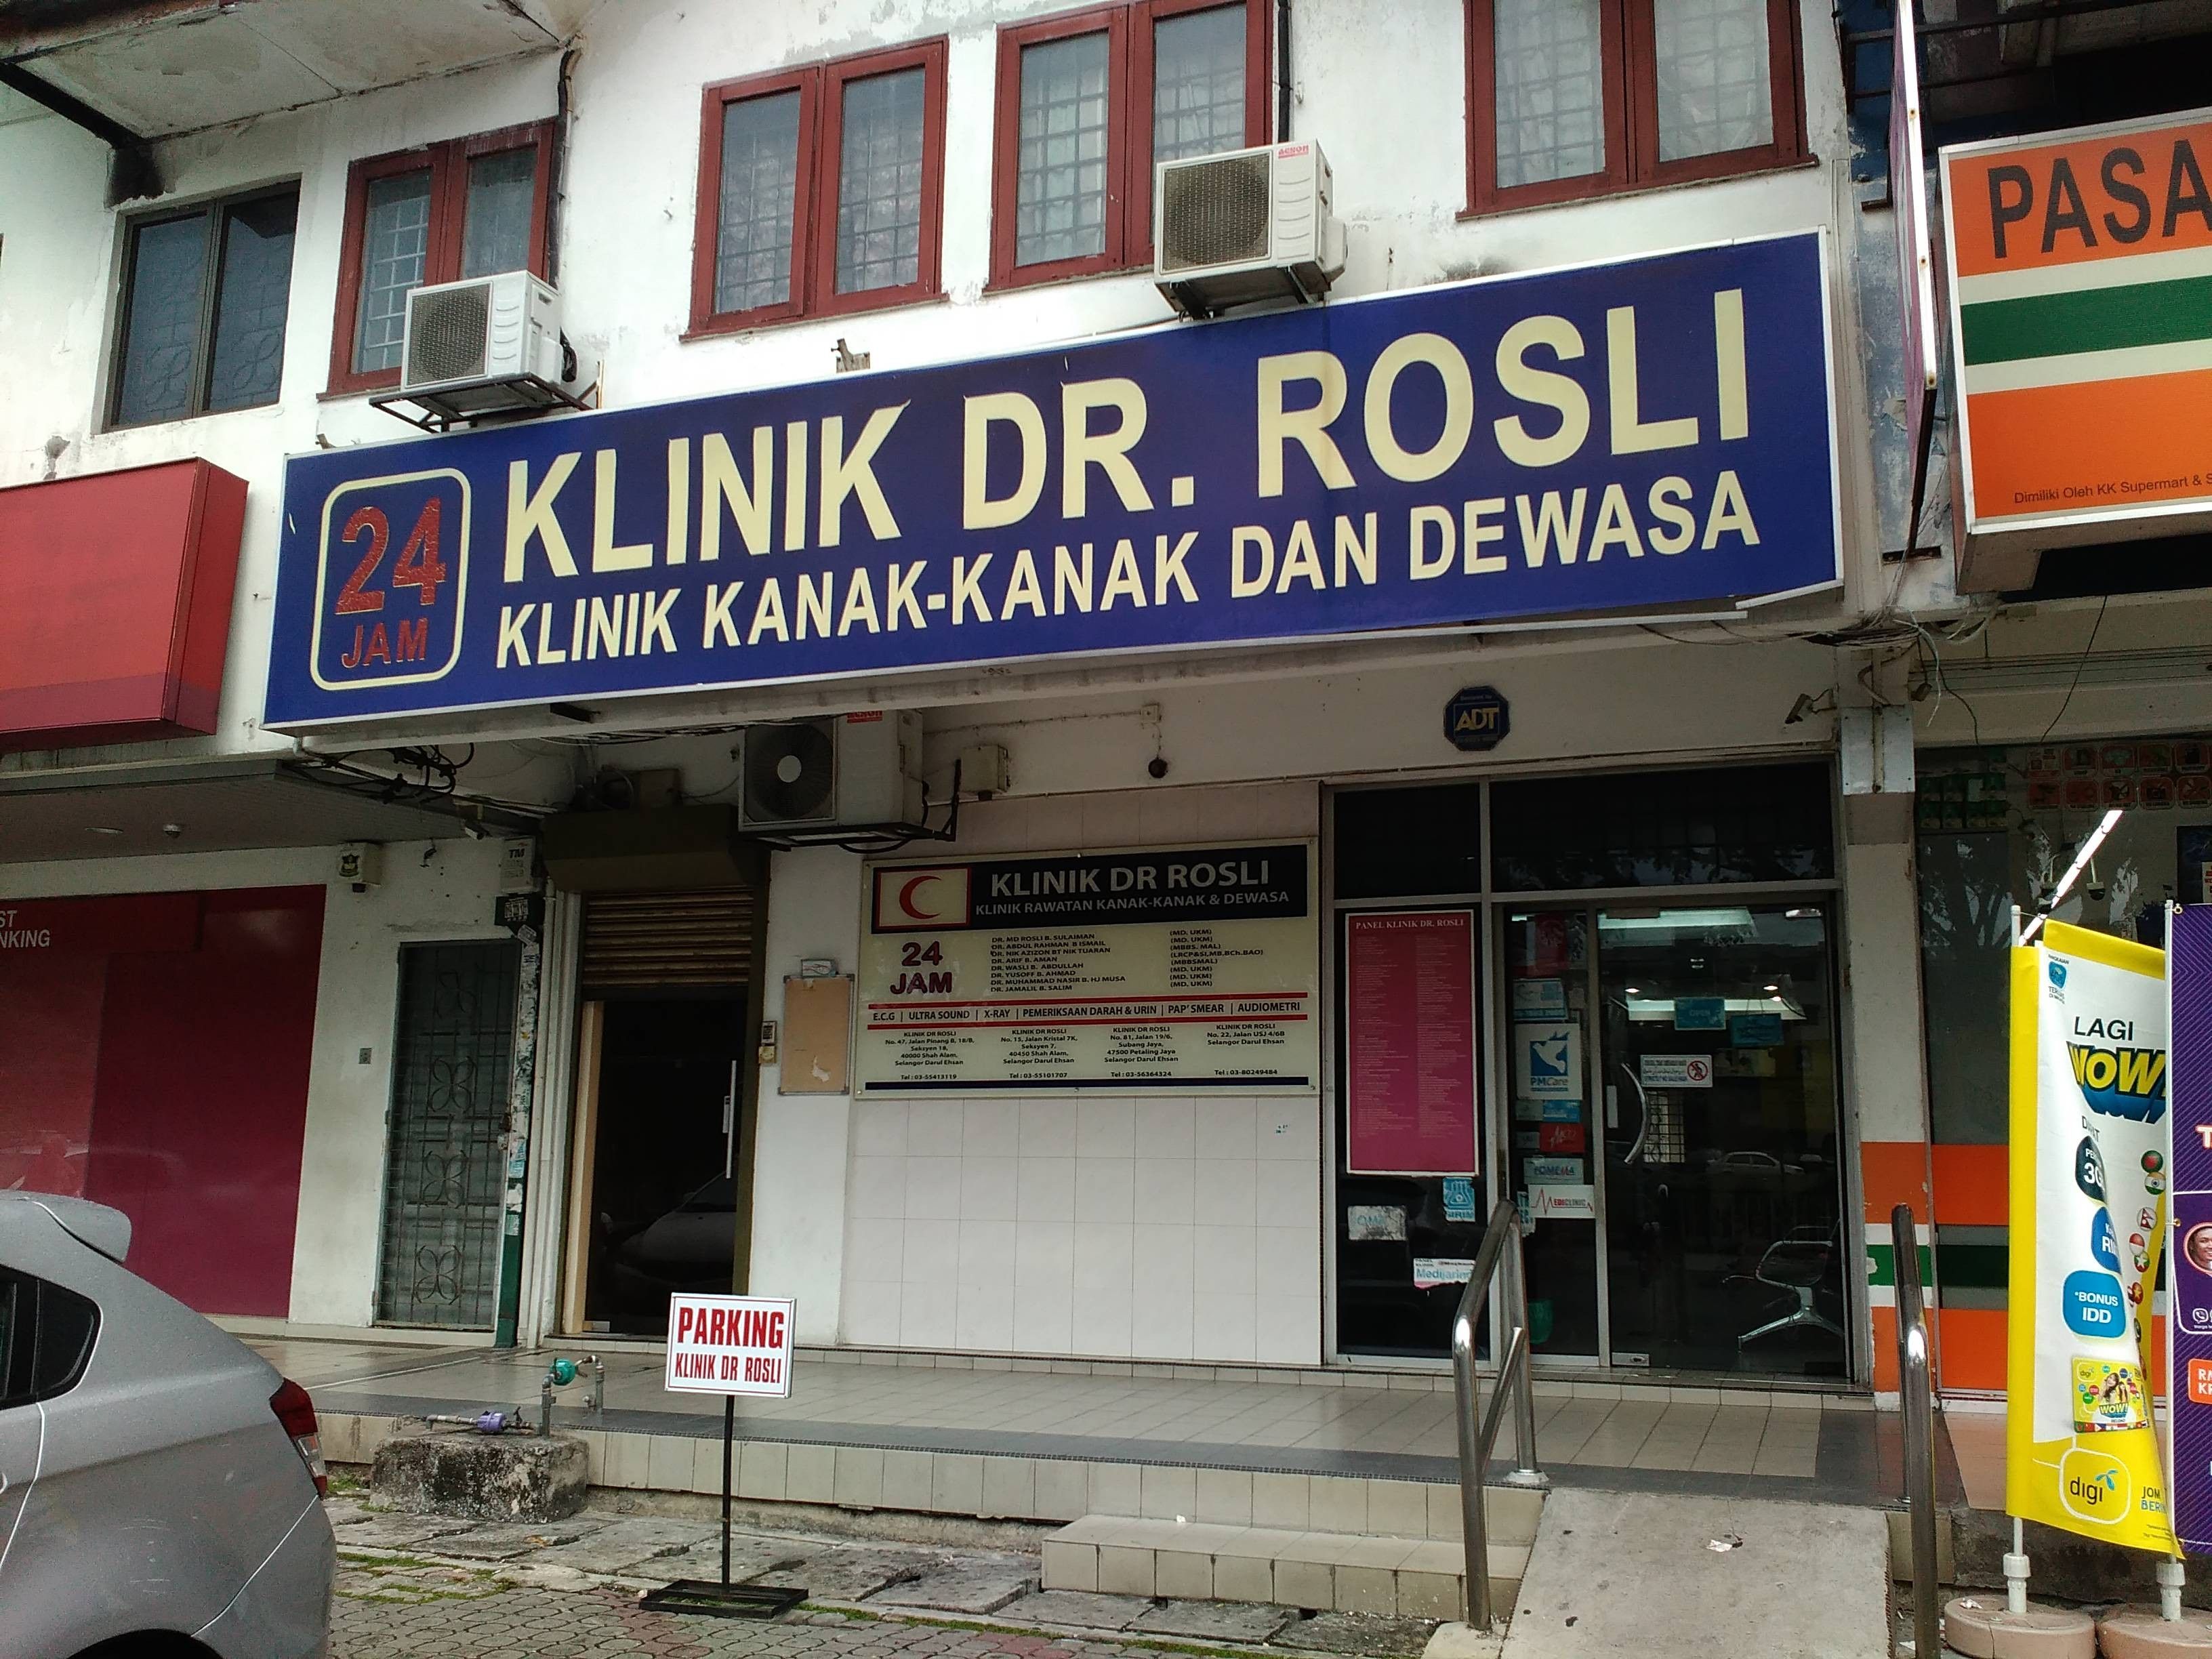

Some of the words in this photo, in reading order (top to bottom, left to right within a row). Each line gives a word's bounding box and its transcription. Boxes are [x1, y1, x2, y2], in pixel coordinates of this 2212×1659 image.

[1988, 139, 2212, 259] PASA
[504, 400, 913, 584] KLINIK
[963, 376, 1194, 530] DR.
[1258, 288, 1750, 498] ROSLI
[2015, 489, 2060, 504] Dimiliki
[2064, 486, 2093, 499] Oleh
[2097, 484, 2117, 495] KK
[2121, 476, 2189, 494] Supermart
[2193, 475, 2203, 485] &
[335, 497, 446, 615] 24
[496, 589, 680, 669] KLINIK
[702, 531, 1200, 651] KANAK-KANAK
[1230, 511, 1378, 600] DAN
[1408, 470, 1760, 581] DEWASA
[342, 617, 428, 668] JAM
[1454, 708, 1500, 731] ADT
[509, 848, 525, 859] TM
[991, 869, 1101, 897] KLINIK
[1110, 866, 1157, 891] DR
[1168, 860, 1268, 888] ROSLI
[976, 903, 1021, 915] KLINIK
[1024, 899, 1093, 913] RAWATAN
[1096, 895, 1206, 910] KANAK-KANAK
[1209, 895, 1220, 904] &
[1224, 891, 1289, 904] DEWASA
[901, 940, 943, 966] 24
[890, 972, 952, 995] JAM
[873, 1012, 895, 1021] E.C.G
[908, 1011, 936, 1021] ULTRA
[938, 1010, 970, 1019] SOUND
[984, 1009, 1010, 1018] X-RAY
[1023, 1006, 1088, 1017] PEMERIKSAAN
[1090, 1006, 1123, 1016] DARAH
[1124, 1006, 1132, 1015] &
[1134, 1005, 1157, 1015] URIN
[1237, 1002, 1300, 1012] AUDIOMETRI
[2074, 1016, 2133, 1041] LAGI
[2067, 1042, 2166, 1101] WOW
[678, 1307, 784, 1349] PARKING
[2082, 1307, 2112, 1324] IDD
[675, 1353, 716, 1380] KLINIK
[721, 1355, 738, 1380] DR
[745, 1357, 781, 1383] ROSLI
[2100, 1402, 2129, 1415] WOW!
[2070, 1477, 2103, 1504] digi
